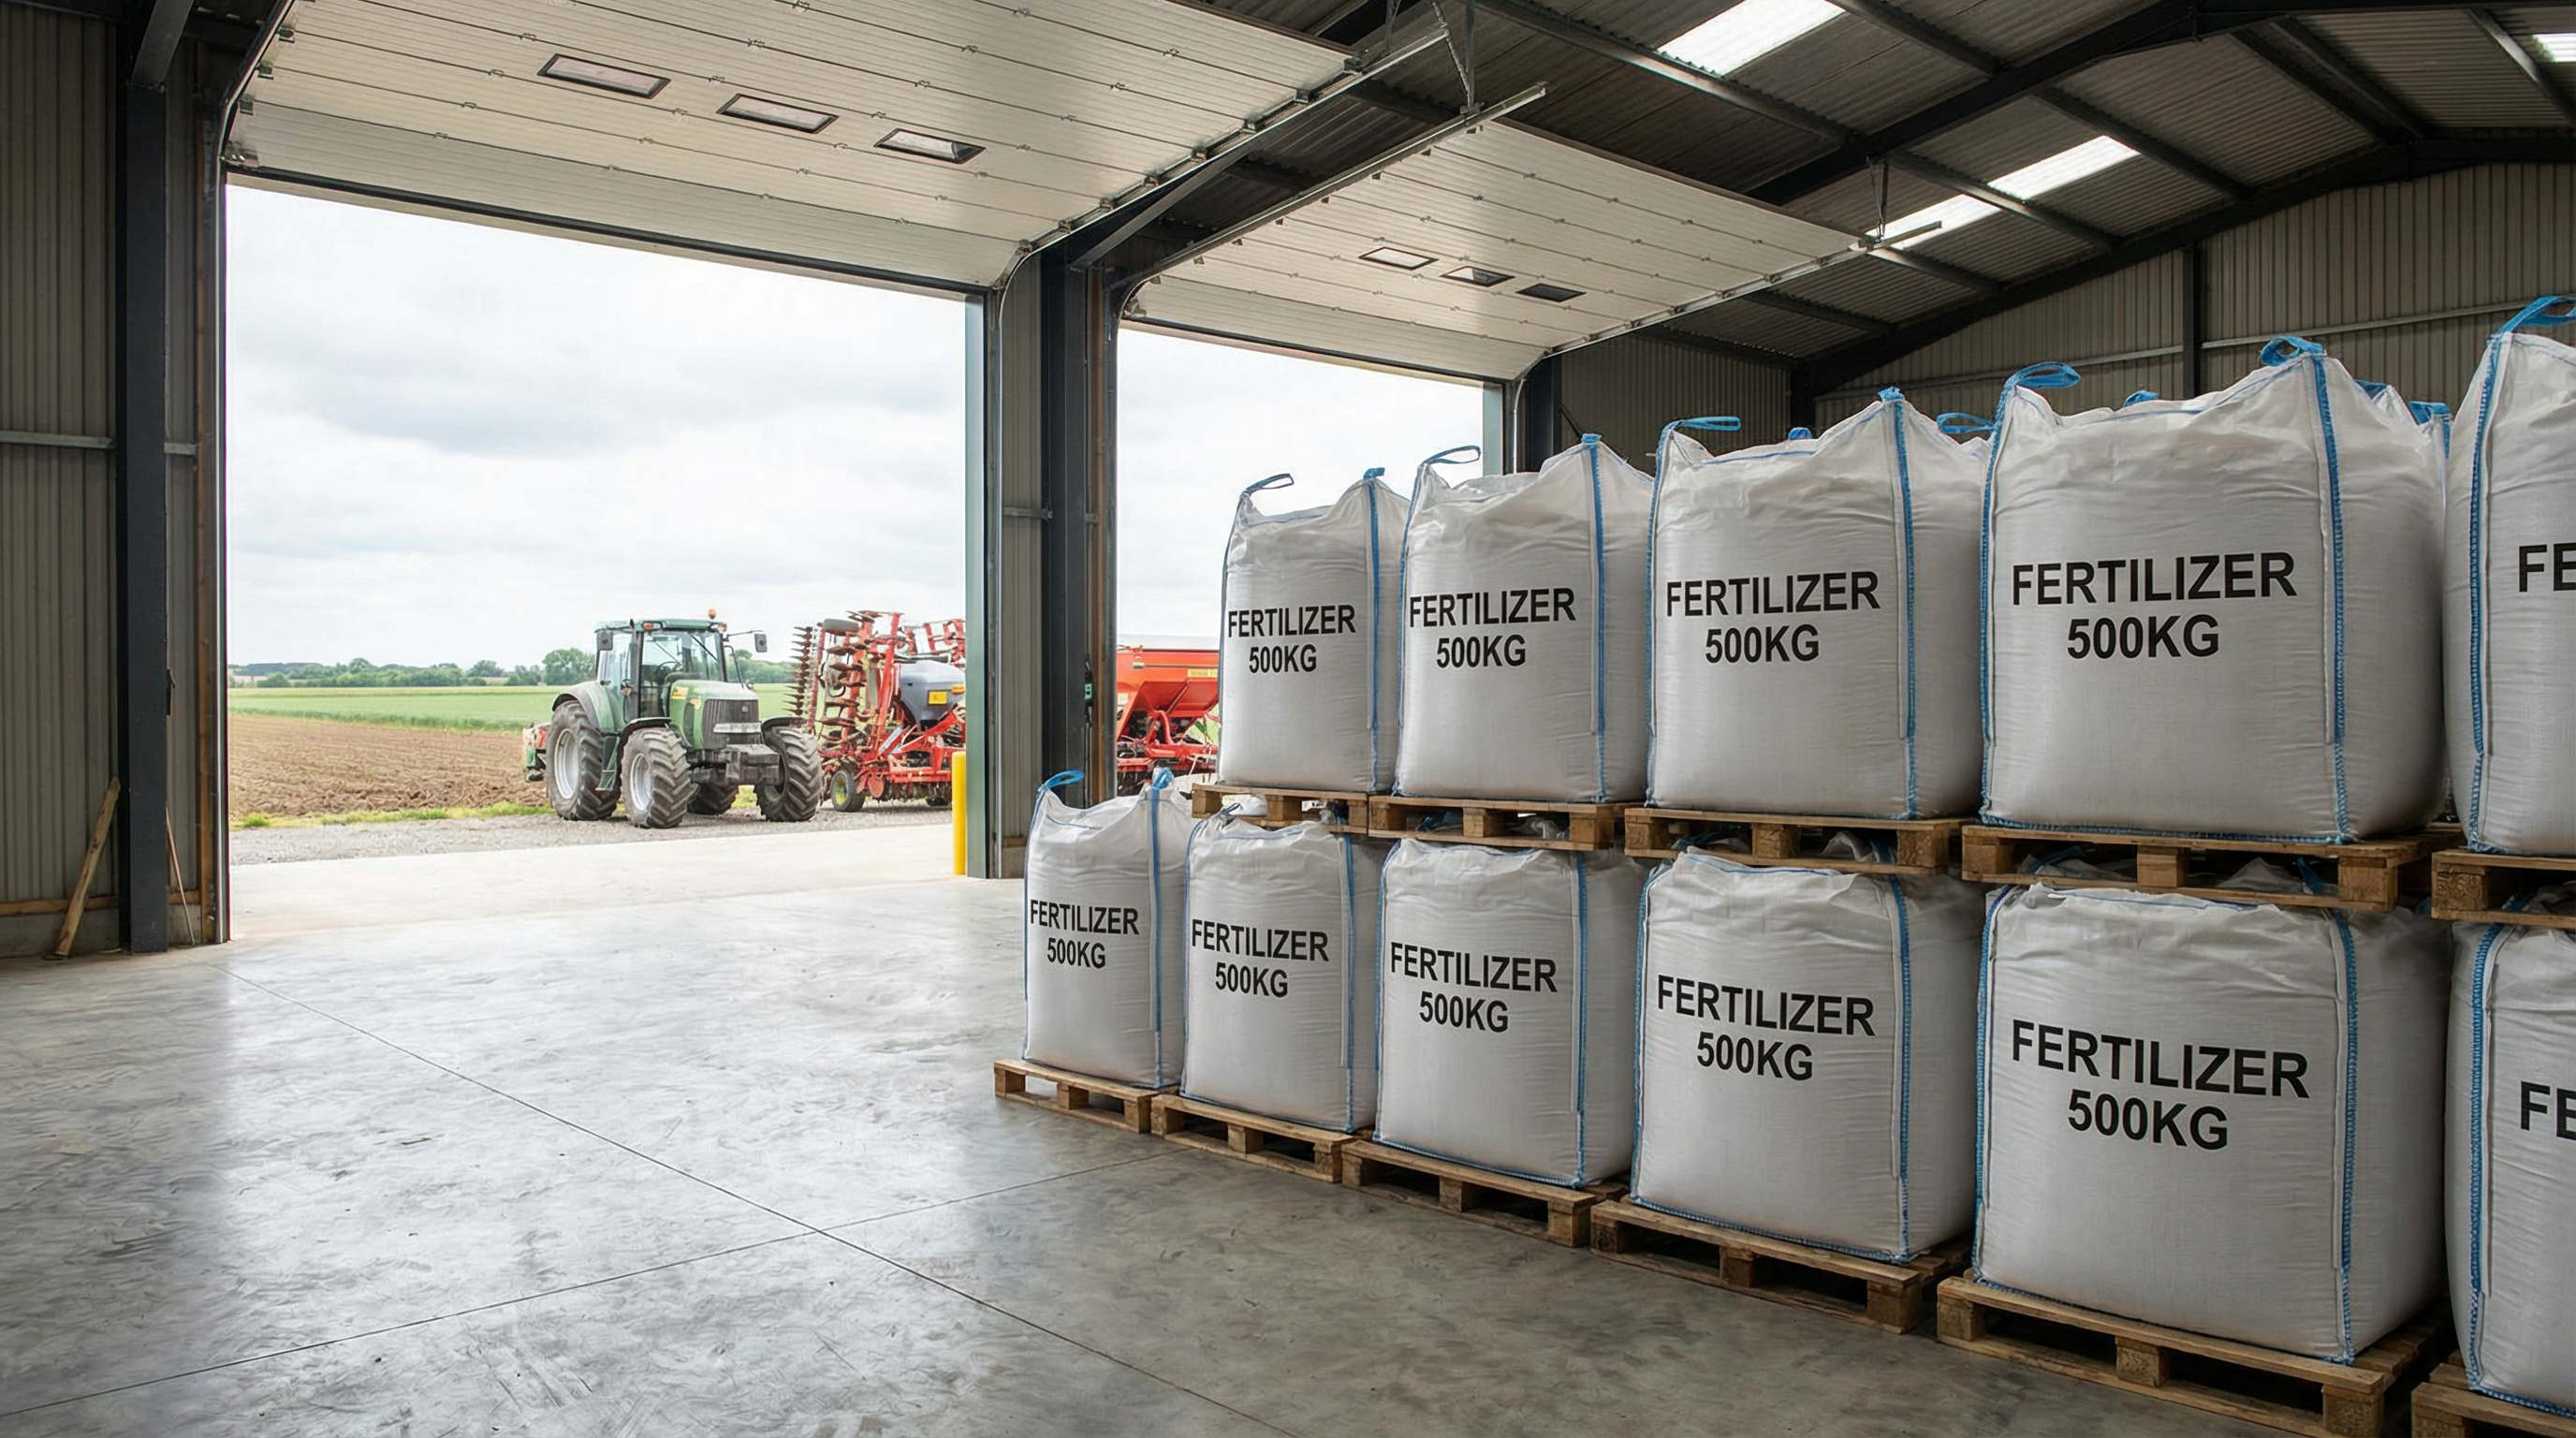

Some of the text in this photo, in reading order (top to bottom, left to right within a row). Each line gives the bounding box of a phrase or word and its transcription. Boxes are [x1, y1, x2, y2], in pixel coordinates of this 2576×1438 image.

[1667, 570, 1881, 617] FERTILIZER
[2012, 551, 2298, 606] FERTILIZER
[1228, 604, 1357, 638] FERTILIZER
[1410, 587, 1577, 628] FERTILIZER
[1436, 634, 1527, 668] 500KG
[1705, 624, 1820, 664] 500KG
[2067, 613, 2219, 660] 500KG
[1249, 643, 1317, 674] 500KG
[1031, 899, 1140, 935] FERTILIZER
[1046, 937, 1106, 969] 500KG
[1192, 918, 1330, 962] FERTILIZER
[1215, 961, 1288, 998] 500KG
[1391, 941, 1559, 993] FERTILIZER
[1419, 991, 1509, 1034] 500KG
[1658, 974, 1876, 1036] FERTILIZER
[1697, 1030, 1814, 1081] 500KG
[2012, 1019, 2310, 1099] FERTILIZER
[2068, 1089, 2228, 1151] 500KG
